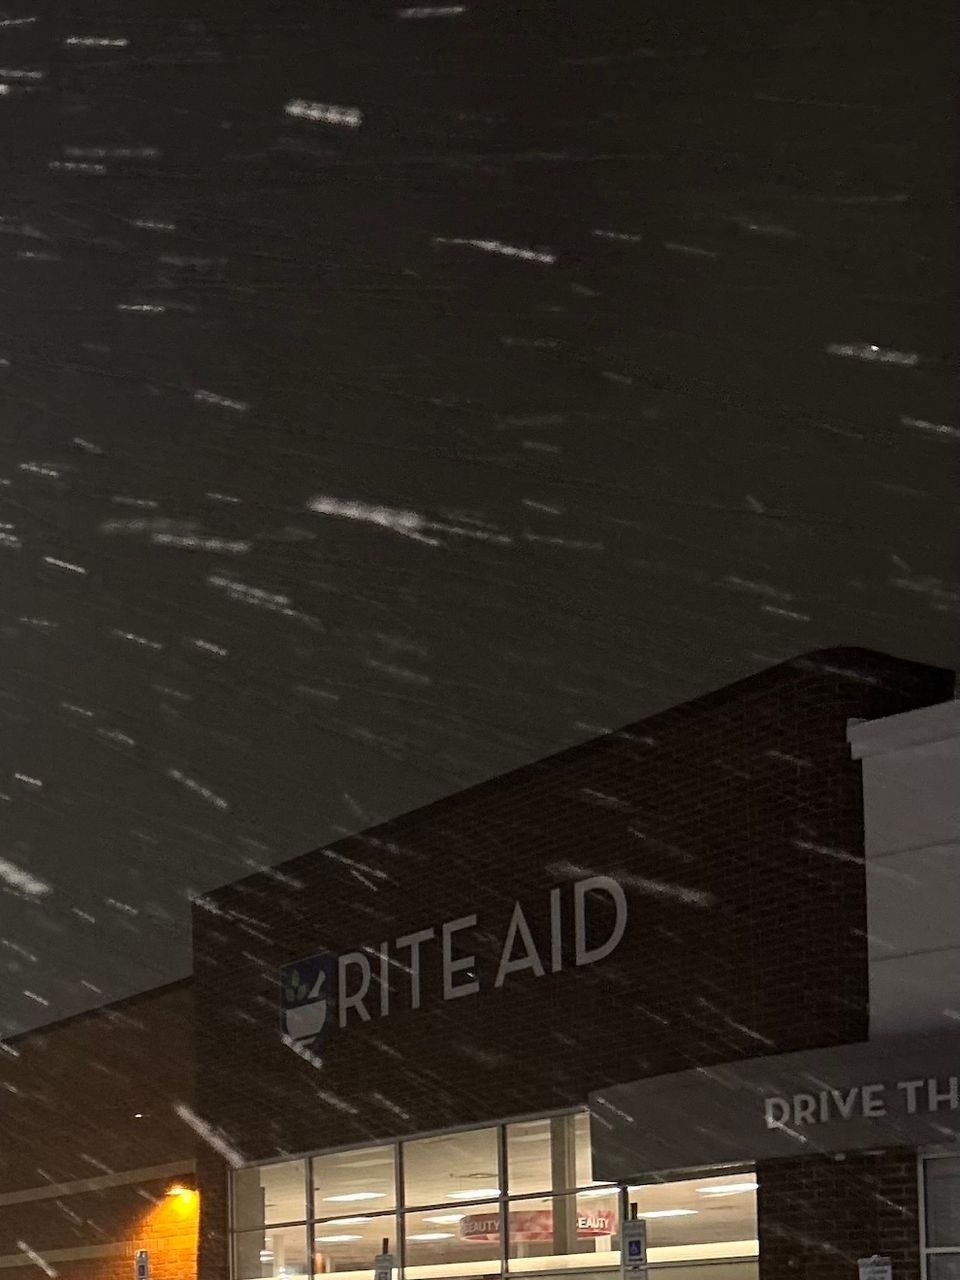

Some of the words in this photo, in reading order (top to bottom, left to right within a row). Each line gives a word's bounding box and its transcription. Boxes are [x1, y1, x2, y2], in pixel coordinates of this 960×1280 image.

[338, 914, 480, 1028] RITE
[494, 876, 628, 988] AID
[765, 1084, 887, 1129] DRIVE
[576, 1216, 609, 1230] EAUTY
